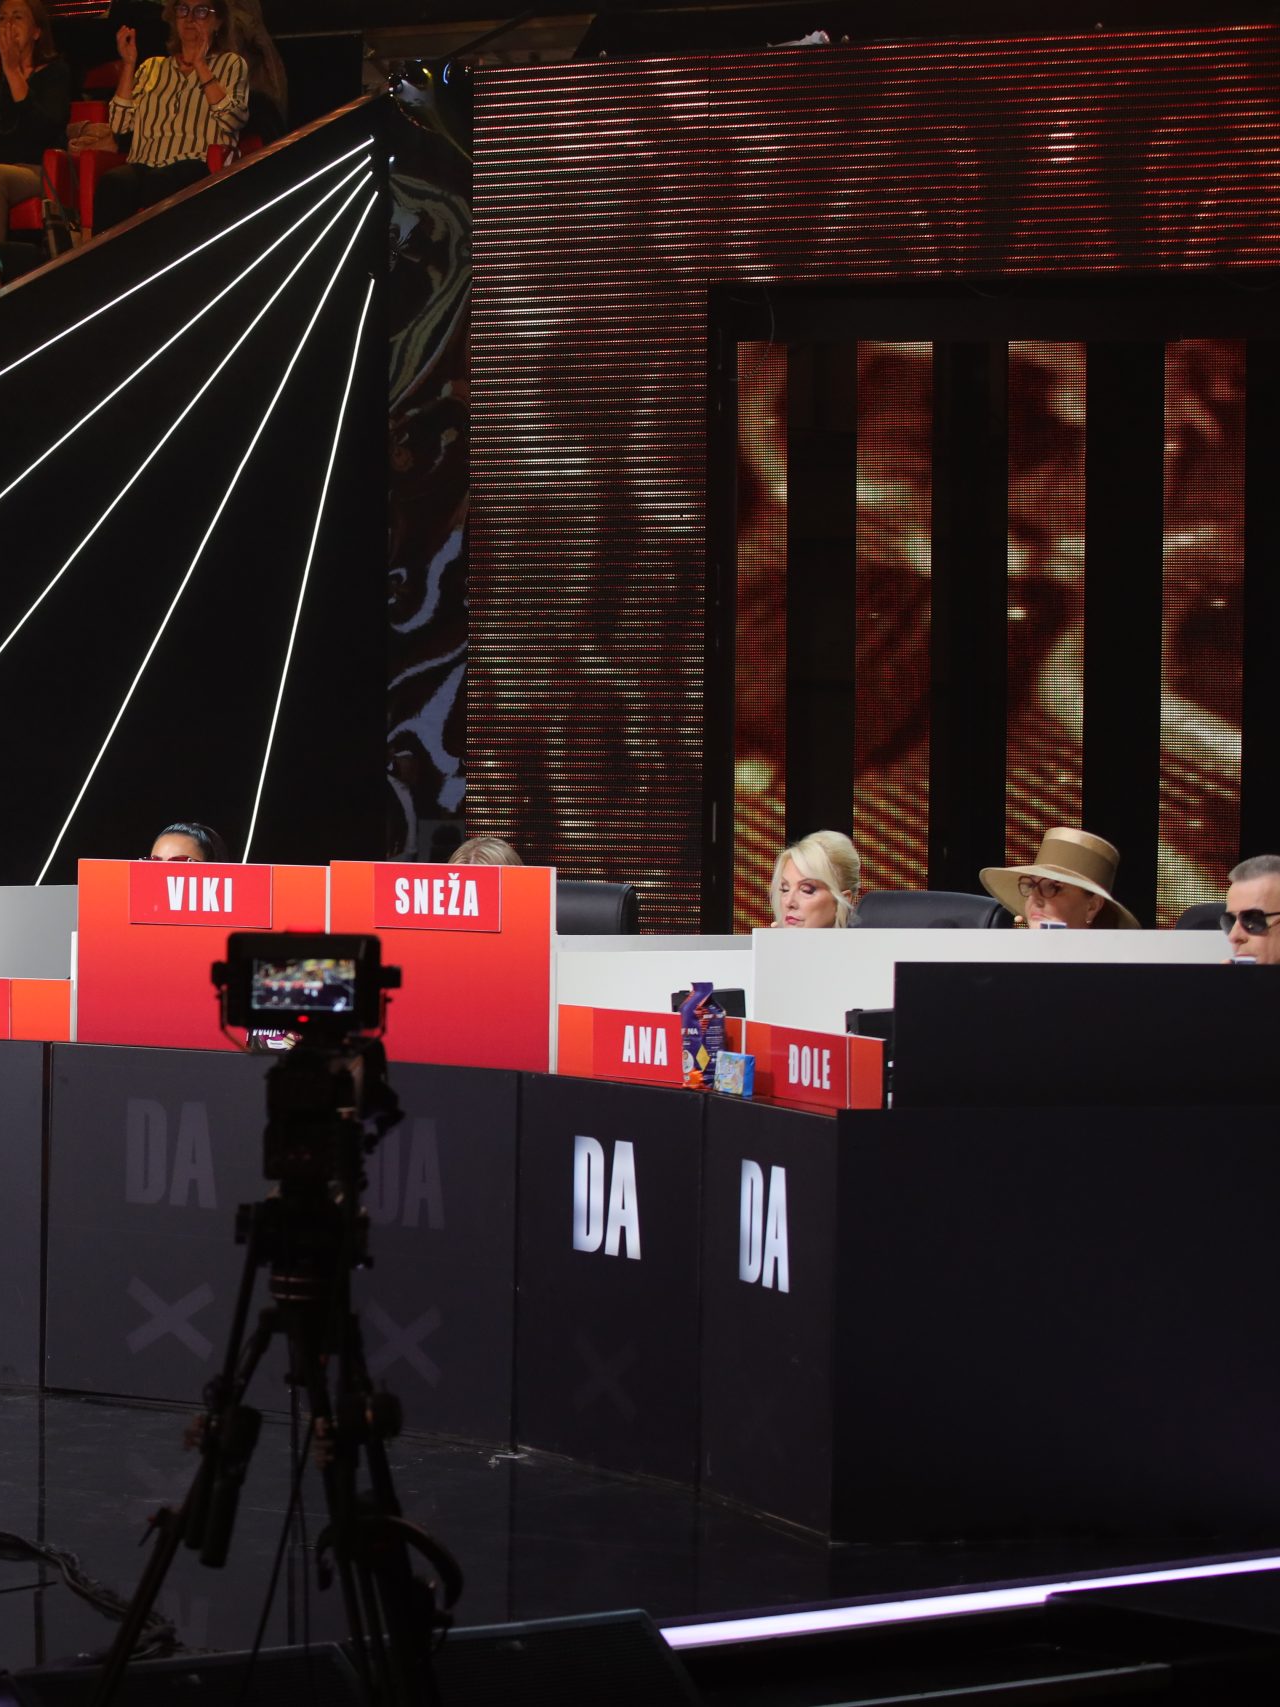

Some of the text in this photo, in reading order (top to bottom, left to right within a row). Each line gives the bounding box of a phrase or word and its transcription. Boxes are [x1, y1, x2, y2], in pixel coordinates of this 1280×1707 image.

[166, 875, 234, 913] VIKI
[394, 872, 480, 917] SNEŽA
[622, 1025, 669, 1066] ANA
[125, 1098, 218, 1210] DA
[572, 1135, 641, 1260] DA
[739, 1159, 791, 1294] DA
